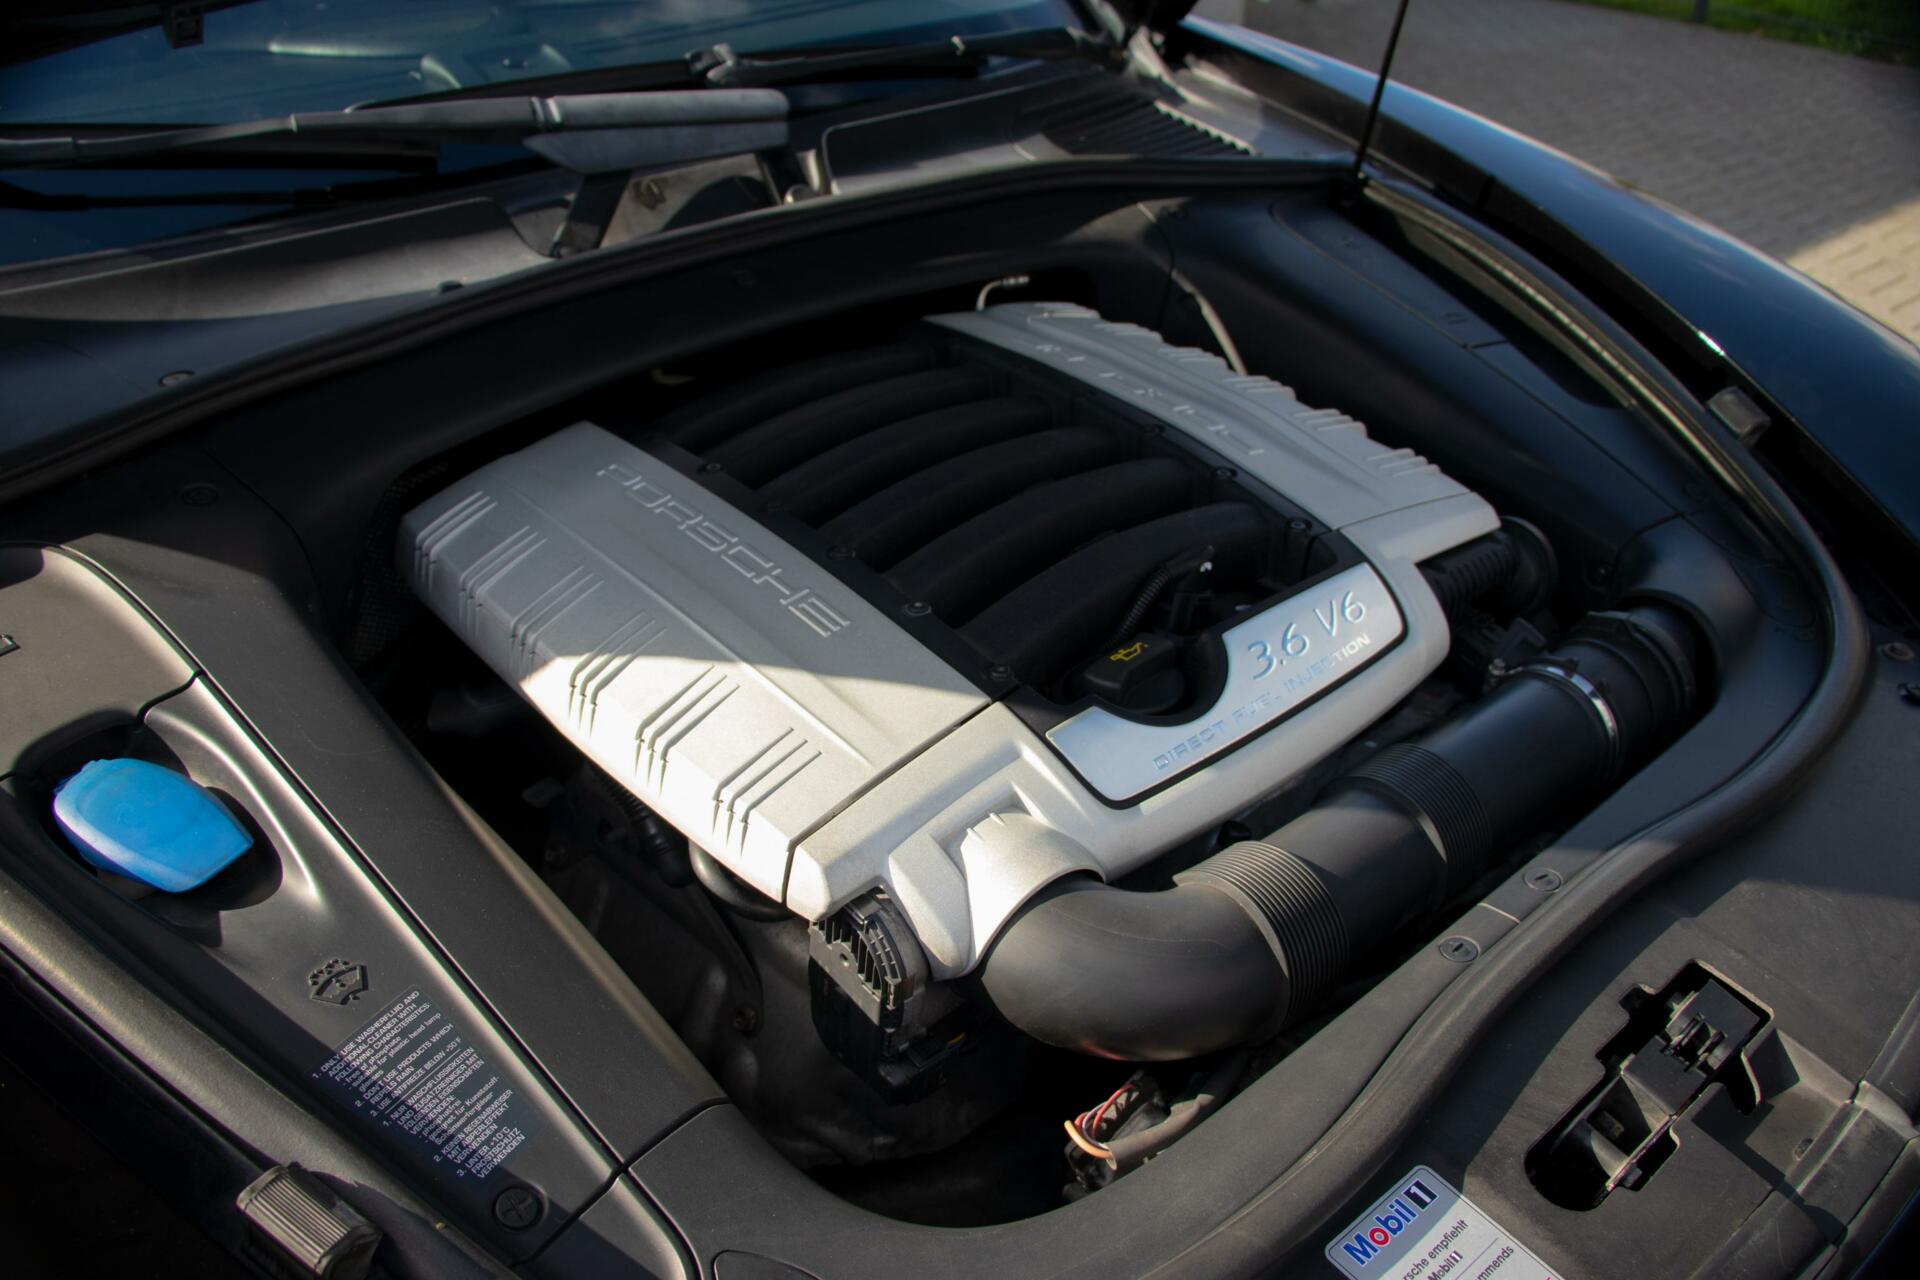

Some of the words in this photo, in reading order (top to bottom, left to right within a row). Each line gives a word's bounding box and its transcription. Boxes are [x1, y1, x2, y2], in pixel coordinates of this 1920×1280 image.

[596, 464, 850, 637] PORSCHE
[1248, 622, 1309, 680] 3.6
[1313, 591, 1366, 637] V6
[1152, 719, 1226, 770] DIRECT
[1283, 633, 1371, 693] INJECTION
[320, 1053, 341, 1072] ONLY
[340, 1040, 356, 1056] USE
[354, 1001, 405, 1043] WASHERFLUID
[402, 989, 420, 1005] AND
[397, 1002, 416, 1019] WITH
[345, 1068, 360, 1083] free
[358, 1061, 368, 1071] of
[367, 1034, 401, 1065] phosphate
[362, 1079, 385, 1100] DON'T
[383, 1067, 399, 1083] USE
[396, 1039, 432, 1071] PRODUCTS
[429, 1022, 453, 1043] WHICH
[376, 1054, 388, 1066] for
[387, 1036, 410, 1058] plastic
[407, 1023, 425, 1040] head
[423, 1010, 442, 1028] lamp
[334, 1047, 374, 1082] FOLLOWING
[369, 1079, 397, 1104] REPELS
[395, 1064, 414, 1082] RAIN
[377, 1096, 391, 1110] USE
[389, 1067, 425, 1099] ANTIFREEZE
[423, 1049, 446, 1070] BELOW
[396, 1108, 415, 1126] UND
[413, 1063, 467, 1111] ZUSATZREINIGER
[465, 1053, 478, 1065] MIT
[389, 1104, 407, 1120] NUR
[403, 1096, 440, 1130] FOLGENDEN
[437, 1058, 484, 1100] EIGENSCHAFTEN
[420, 1098, 463, 1136] phosphatfrei
[427, 1113, 458, 1141] geeignet
[440, 1131, 465, 1154] KEINEN
[463, 1088, 513, 1134] REGENABWEISER
[447, 1145, 462, 1160] MIT
[460, 1101, 510, 1147] ABPERLEFFEKT
[453, 1122, 498, 1164] VERWENDEN
[464, 1144, 490, 1168] UNTER
[471, 1126, 521, 1174] FROSTSCHUTZ
[477, 1132, 526, 1179] VERWENDEN
[1343, 1199, 1416, 1266] Mobil
[1428, 1219, 1468, 1260] empfiehlt
